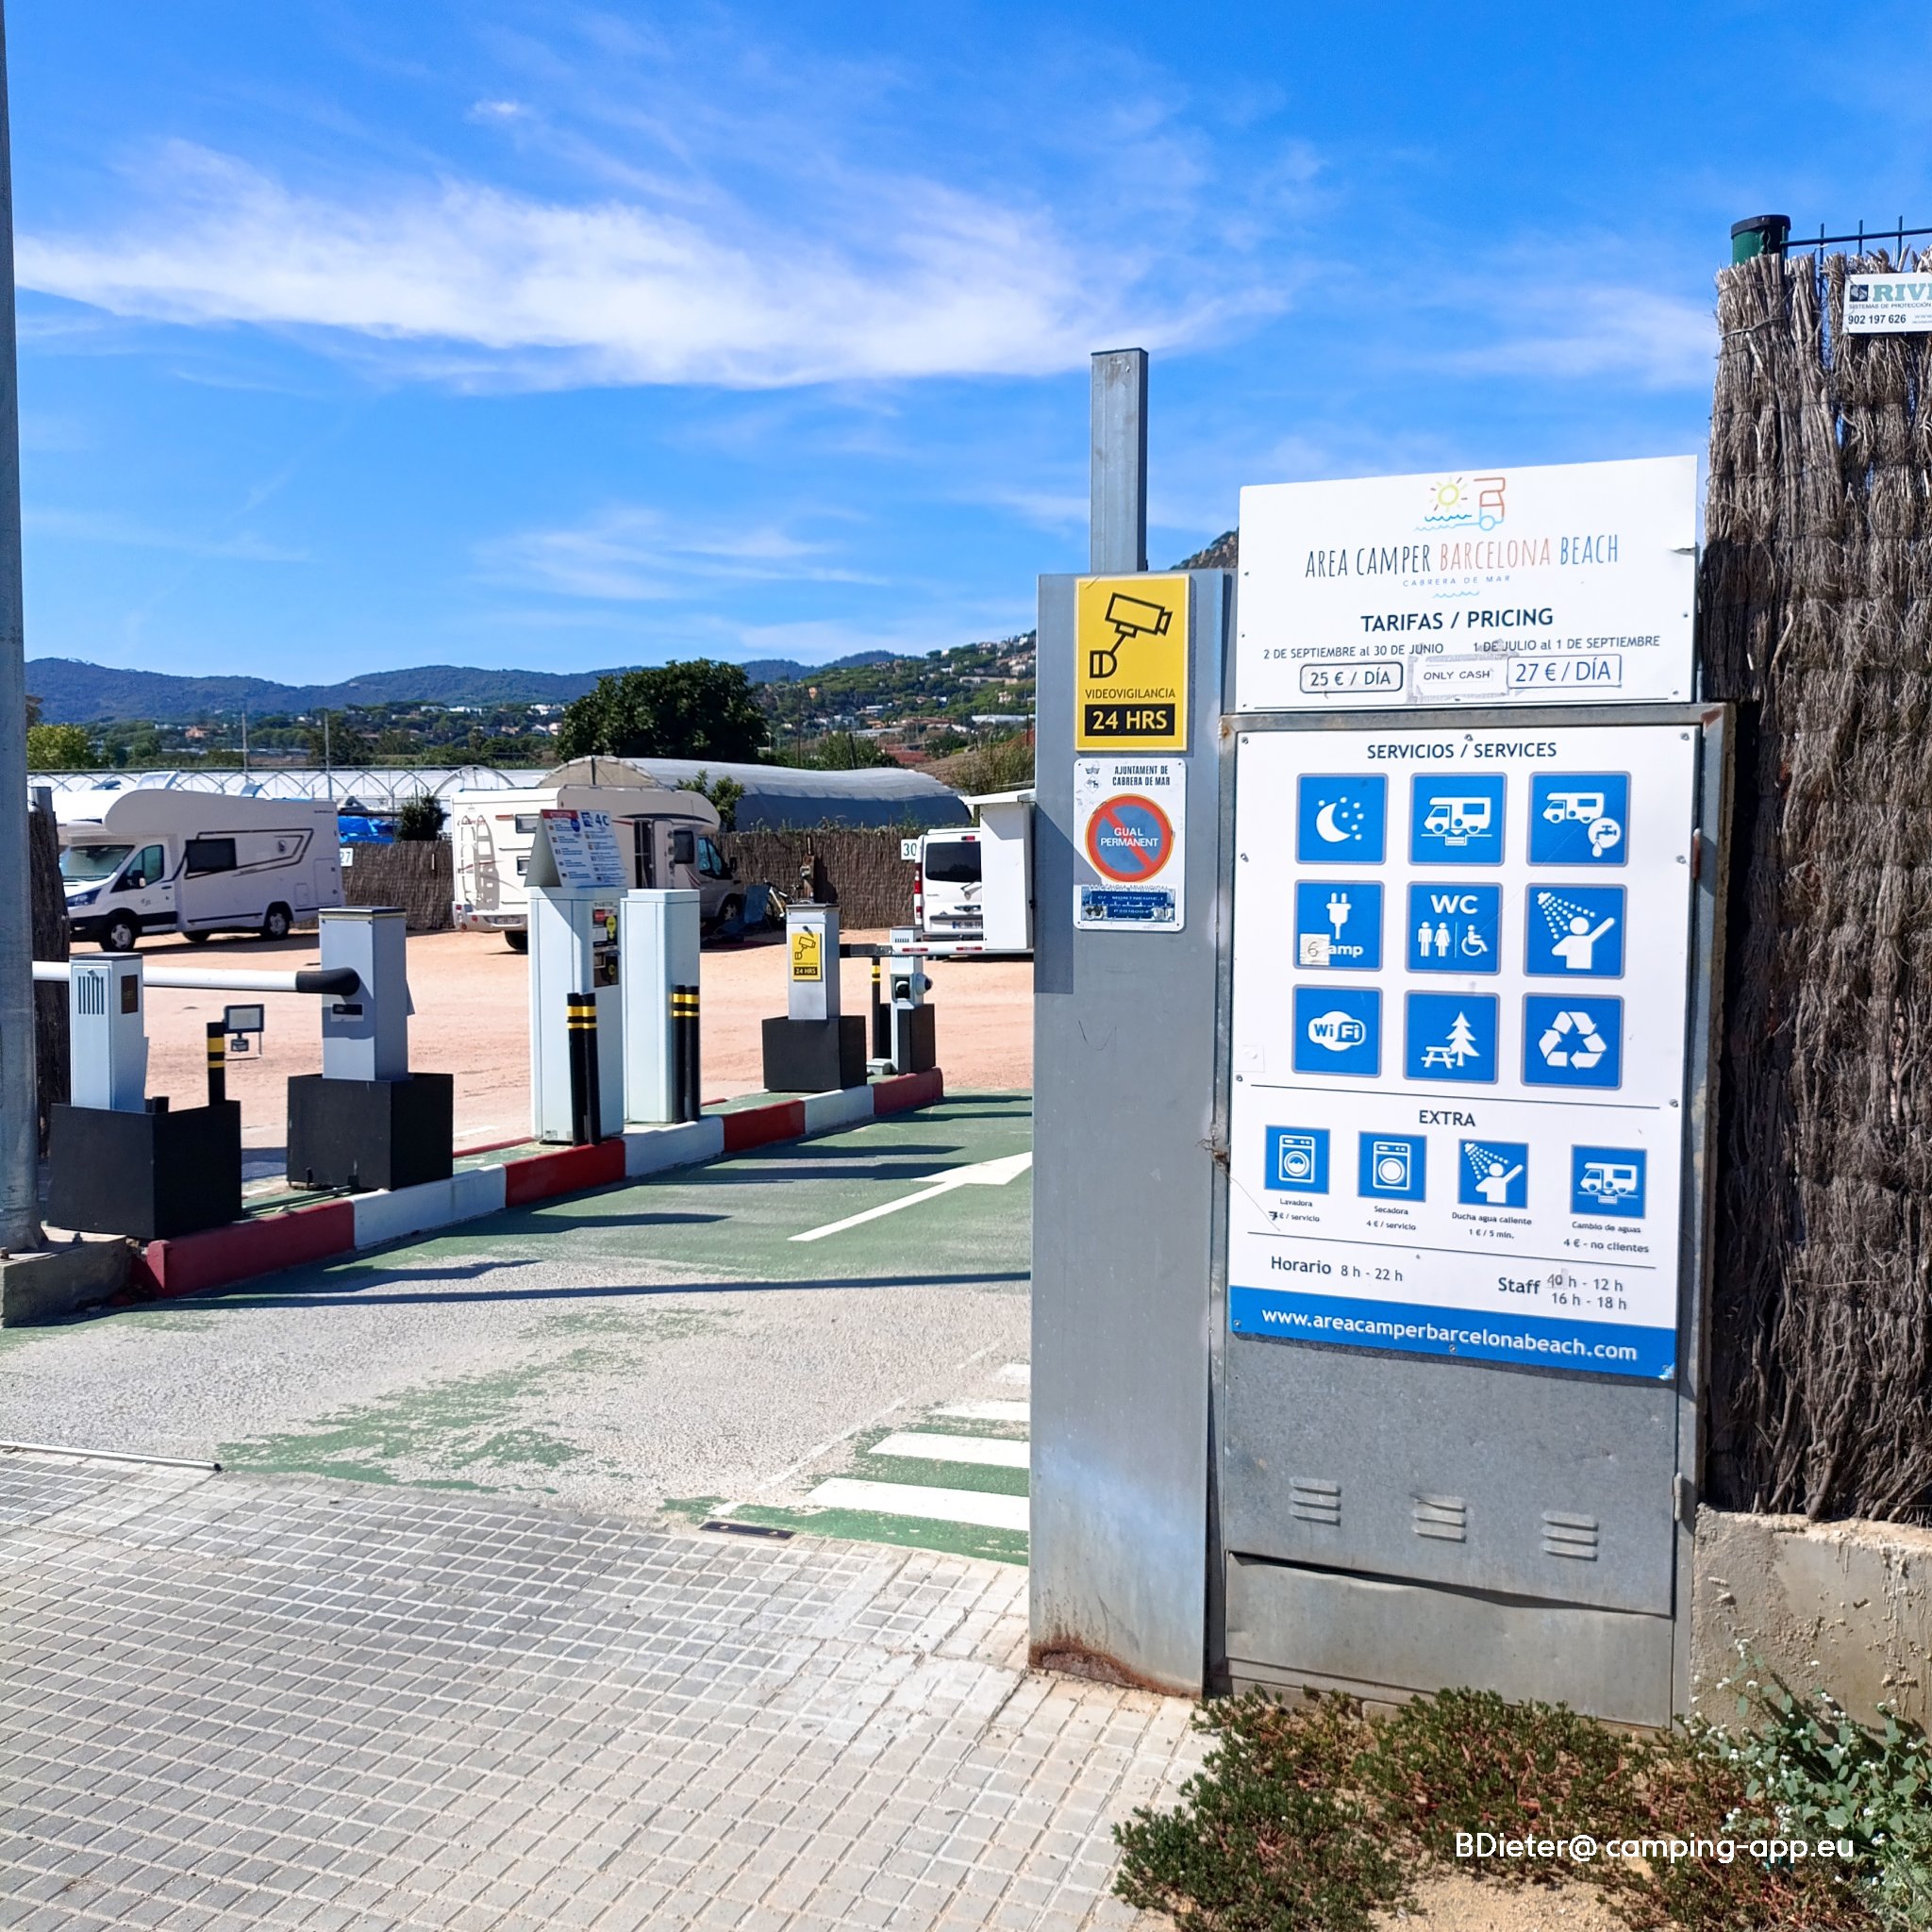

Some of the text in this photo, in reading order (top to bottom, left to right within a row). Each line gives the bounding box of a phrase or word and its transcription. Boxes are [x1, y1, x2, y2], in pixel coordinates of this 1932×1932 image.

[1848, 314, 1907, 325] 902 197 626
[1306, 534, 1619, 578] AREA CAMPER BARCELONA BEACH
[1403, 578, 1457, 587] CABRERA
[1486, 575, 1510, 583] MAR
[1360, 608, 1554, 633] TARIFAS / PRICING
[1263, 642, 1444, 659] 2 DE SEPTIEMBRE al 30 DE JUNIO
[1473, 635, 1660, 653] 1 DE JULIO al 1 DE SEPTIEMBRE
[1310, 666, 1391, 687] 25 € / DÍA
[1423, 669, 1491, 681] ONLY CASH
[1515, 657, 1611, 683] 27 € / DÍA
[1085, 688, 1175, 700] VIDEOVIGILANCIA
[1091, 710, 1168, 730] 24 HRS
[1367, 741, 1557, 759] SERVICIOS / SERVICES
[1114, 765, 1168, 775] AJUNTAMENT DE
[1112, 776, 1171, 786] CABRERA DE MAR
[1114, 827, 1143, 837] GUAL
[903, 842, 917, 857] 30
[1100, 838, 1159, 847] PERMANENT
[1430, 894, 1478, 914] WC
[1307, 941, 1320, 958] 6
[1419, 1109, 1476, 1127] EXTRA
[1279, 1198, 1313, 1208] Lavadora
[1374, 1206, 1408, 1215] Secadora
[1291, 1214, 1320, 1223] servicio
[1386, 1222, 1417, 1231] servicio
[1452, 1212, 1476, 1221] Ducha
[1499, 1216, 1532, 1225] caliente
[1572, 1221, 1641, 1234] Cambio de aguas
[1563, 1239, 1570, 1247] 4
[1574, 1239, 1580, 1248] €
[1591, 1241, 1604, 1250] no
[1607, 1241, 1650, 1254] clientes
[1271, 1256, 1332, 1274] Horario
[1341, 1265, 1348, 1277] 8
[1353, 1266, 1360, 1278] h
[1374, 1268, 1390, 1281] 22
[1394, 1270, 1404, 1282] h
[1498, 1277, 1541, 1295] Staff
[1569, 1274, 1577, 1288] h
[1594, 1278, 1609, 1291] 12
[1614, 1279, 1624, 1292] h
[1552, 1292, 1567, 1305] 16
[1573, 1293, 1581, 1307] h
[1598, 1296, 1613, 1309] 18
[1618, 1298, 1627, 1310] h
[1262, 1308, 1638, 1361] www.areacamperbarcelonabeach.com
